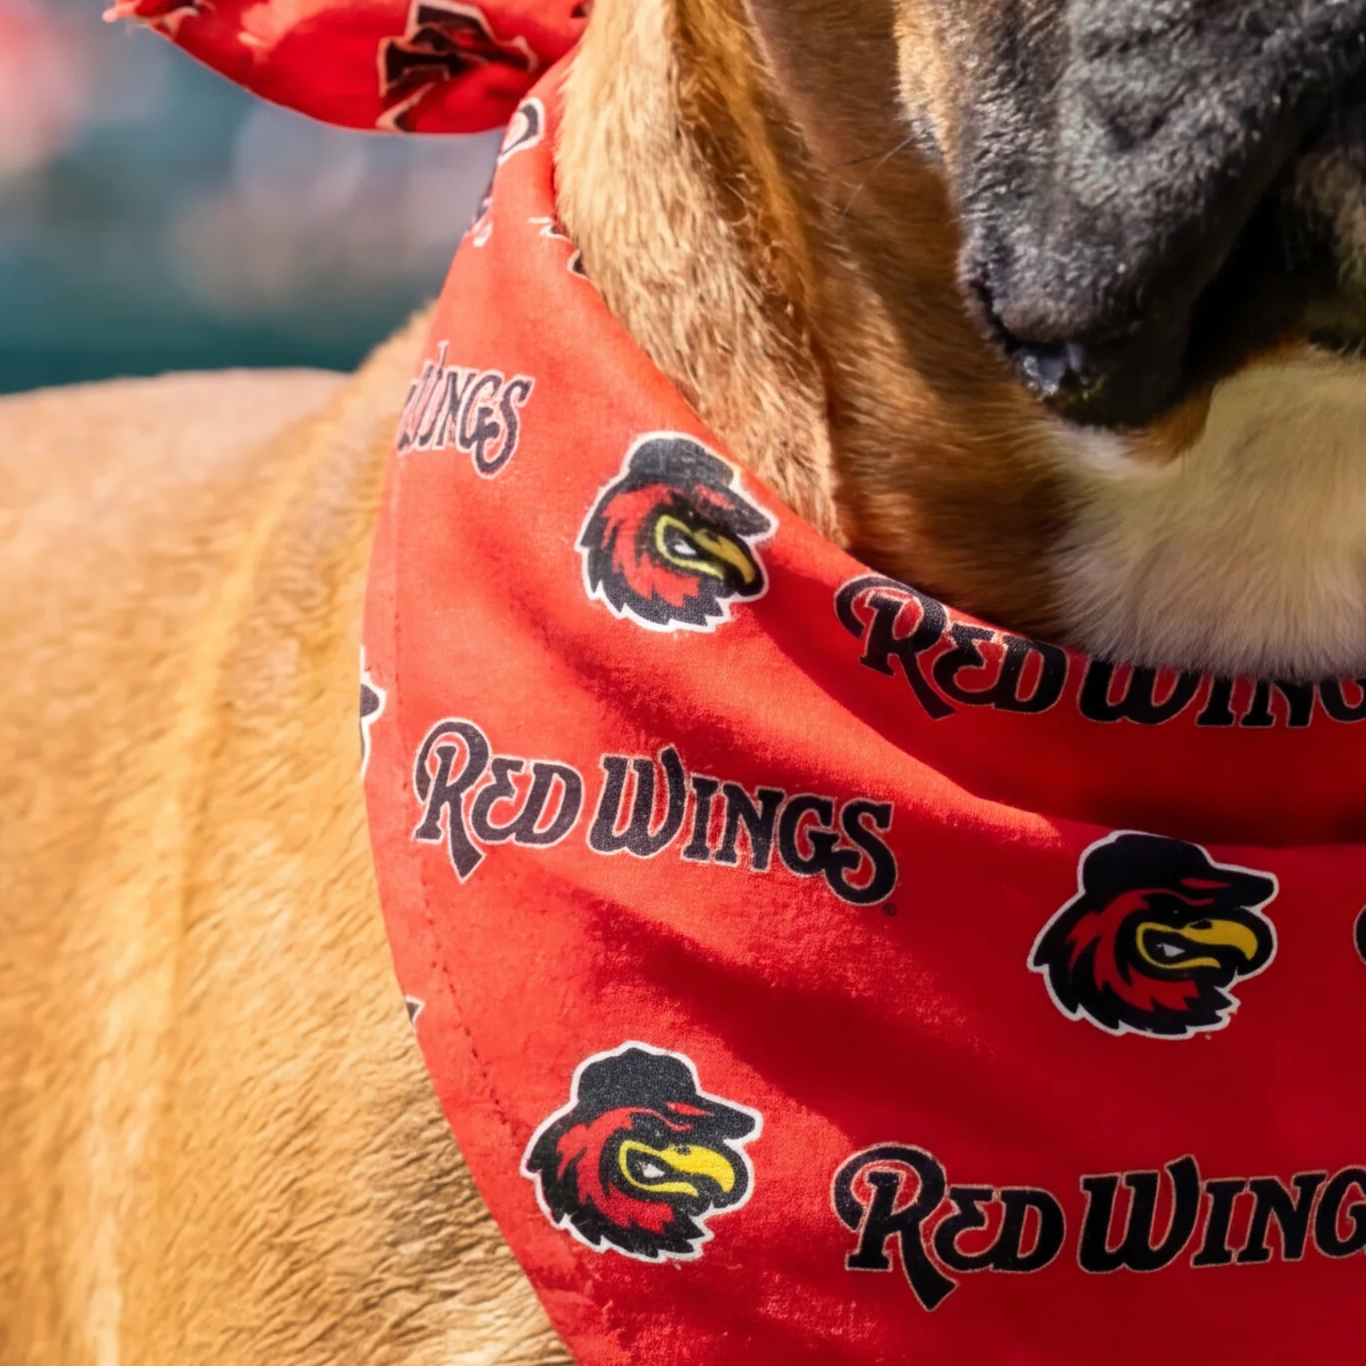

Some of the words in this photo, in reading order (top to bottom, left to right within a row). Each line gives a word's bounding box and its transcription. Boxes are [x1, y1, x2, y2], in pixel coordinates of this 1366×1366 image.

[835, 572, 1070, 721] RED
[412, 717, 585, 884] RED
[587, 743, 899, 906] WINGS
[832, 1141, 1067, 1312] RED
